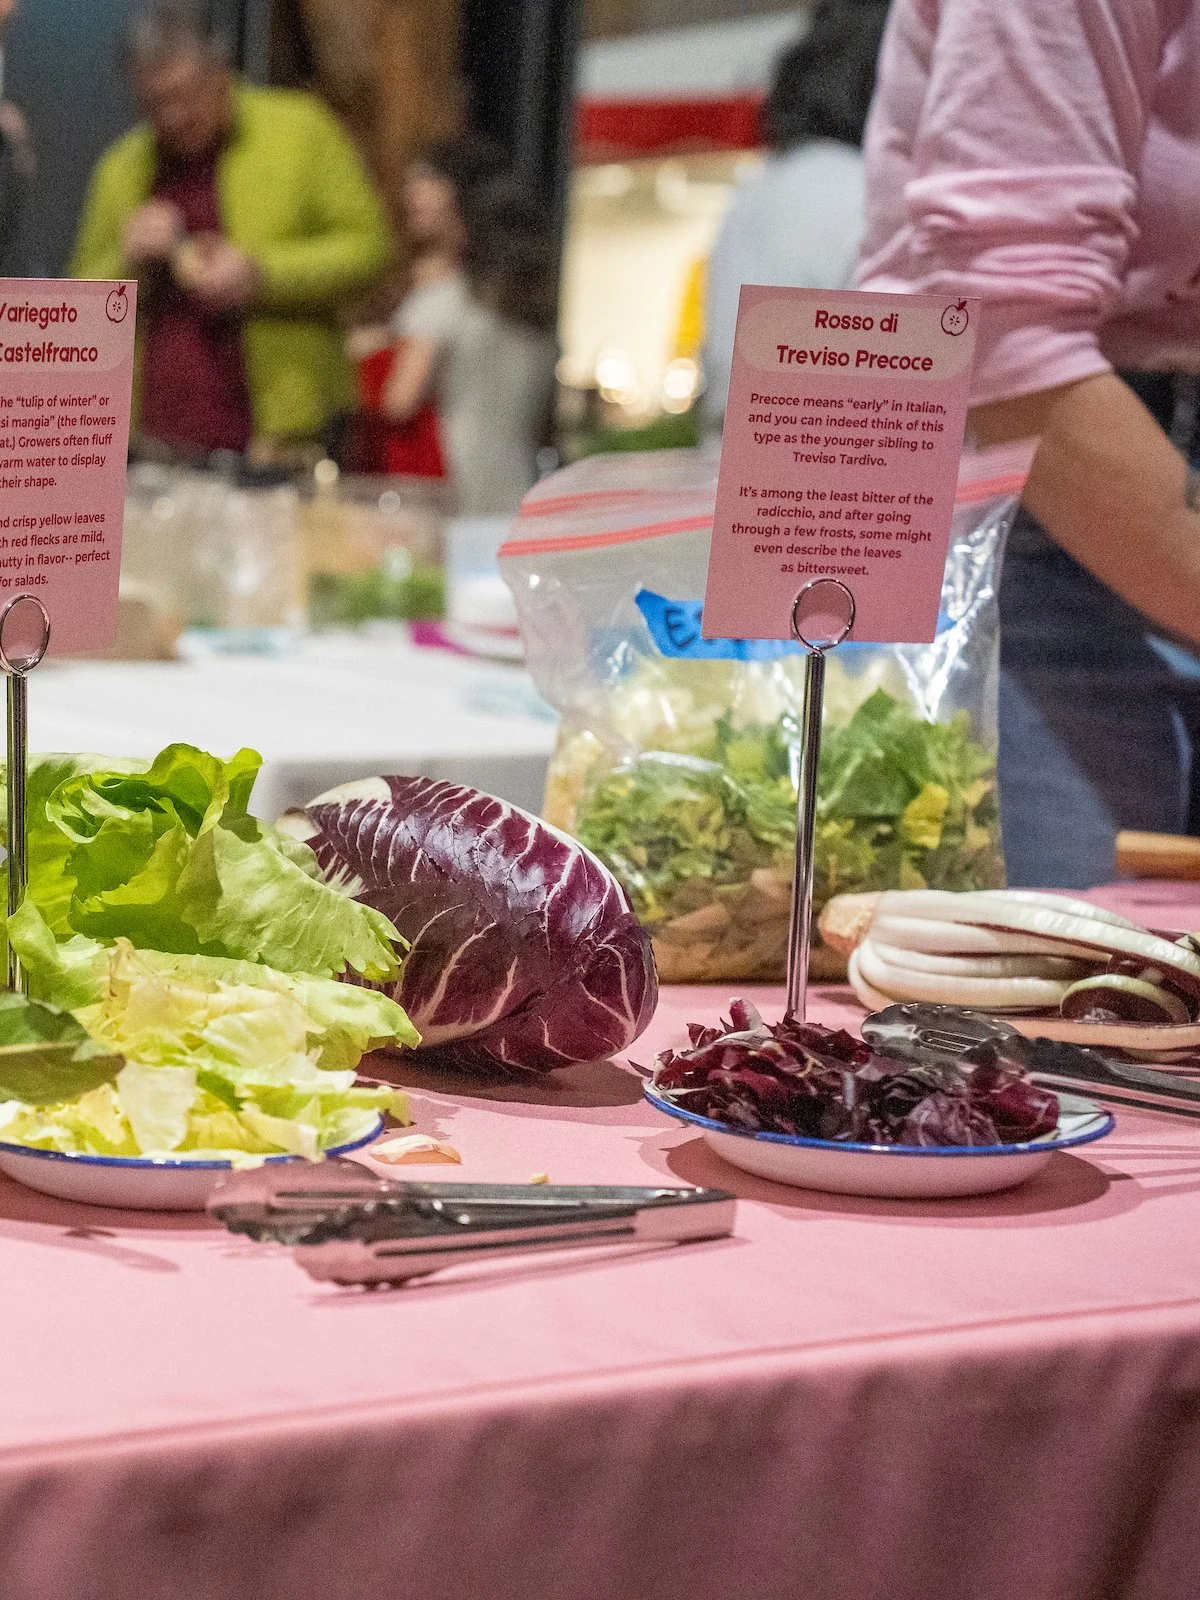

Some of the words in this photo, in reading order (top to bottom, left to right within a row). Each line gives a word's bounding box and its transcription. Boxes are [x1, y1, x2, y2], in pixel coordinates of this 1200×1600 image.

[814, 309, 874, 330] Rosso
[879, 313, 898, 332] di
[776, 344, 850, 366] Treviso
[855, 349, 933, 371] Precoce
[46, 394, 57, 407] of
[98, 396, 109, 406] or
[750, 392, 800, 406] Precoce
[802, 397, 844, 408] means
[890, 399, 903, 411] in
[905, 401, 946, 414] Italian,
[0, 415, 9, 428] si
[56, 414, 77, 429] (the
[79, 414, 116, 426] flowers
[748, 412, 772, 423] and
[774, 415, 797, 426] you
[800, 416, 823, 425] can
[825, 415, 868, 428] indeed
[870, 417, 902, 430] think
[905, 419, 919, 431] of
[921, 420, 944, 432] this
[18, 435, 61, 448] Growers
[62, 434, 90, 446] often
[91, 432, 112, 445] fluff
[753, 431, 781, 444] type
[783, 434, 797, 443] as
[800, 432, 821, 445] the
[823, 436, 875, 449] younger
[877, 436, 918, 452] sibling
[921, 439, 934, 450] to
[26, 456, 56, 467] water
[57, 455, 69, 466] to
[70, 453, 106, 467] display
[793, 451, 836, 464] Treviso
[839, 453, 887, 466] Tardivo.
[24, 476, 56, 488] shape.
[760, 489, 803, 502] among
[806, 489, 827, 500] the
[829, 490, 859, 502] least
[861, 491, 895, 503] bitter
[898, 492, 911, 504] of
[913, 493, 934, 505] the
[12, 515, 37, 528] crisp
[38, 513, 72, 528] yellow
[74, 512, 105, 524] leaves
[756, 506, 815, 519] radicchio,
[818, 508, 842, 519] and
[844, 508, 874, 521] after
[876, 510, 912, 525] going
[10, 535, 28, 547] red
[30, 533, 60, 546] flecks
[62, 534, 78, 544] are
[80, 530, 105, 542] mild,
[731, 522, 780, 537] through
[783, 526, 791, 536] a
[794, 525, 817, 536] few
[819, 526, 856, 539] frosts,
[859, 530, 892, 540] some
[894, 529, 932, 543] might
[24, 553, 35, 566] in
[74, 549, 110, 564] perfect
[753, 544, 783, 553] even
[786, 543, 837, 556] describe
[840, 545, 861, 557] the
[863, 546, 902, 558] leaves
[780, 563, 794, 572] as
[796, 561, 869, 575] bittersweet.
[14, 573, 48, 586] salads.
